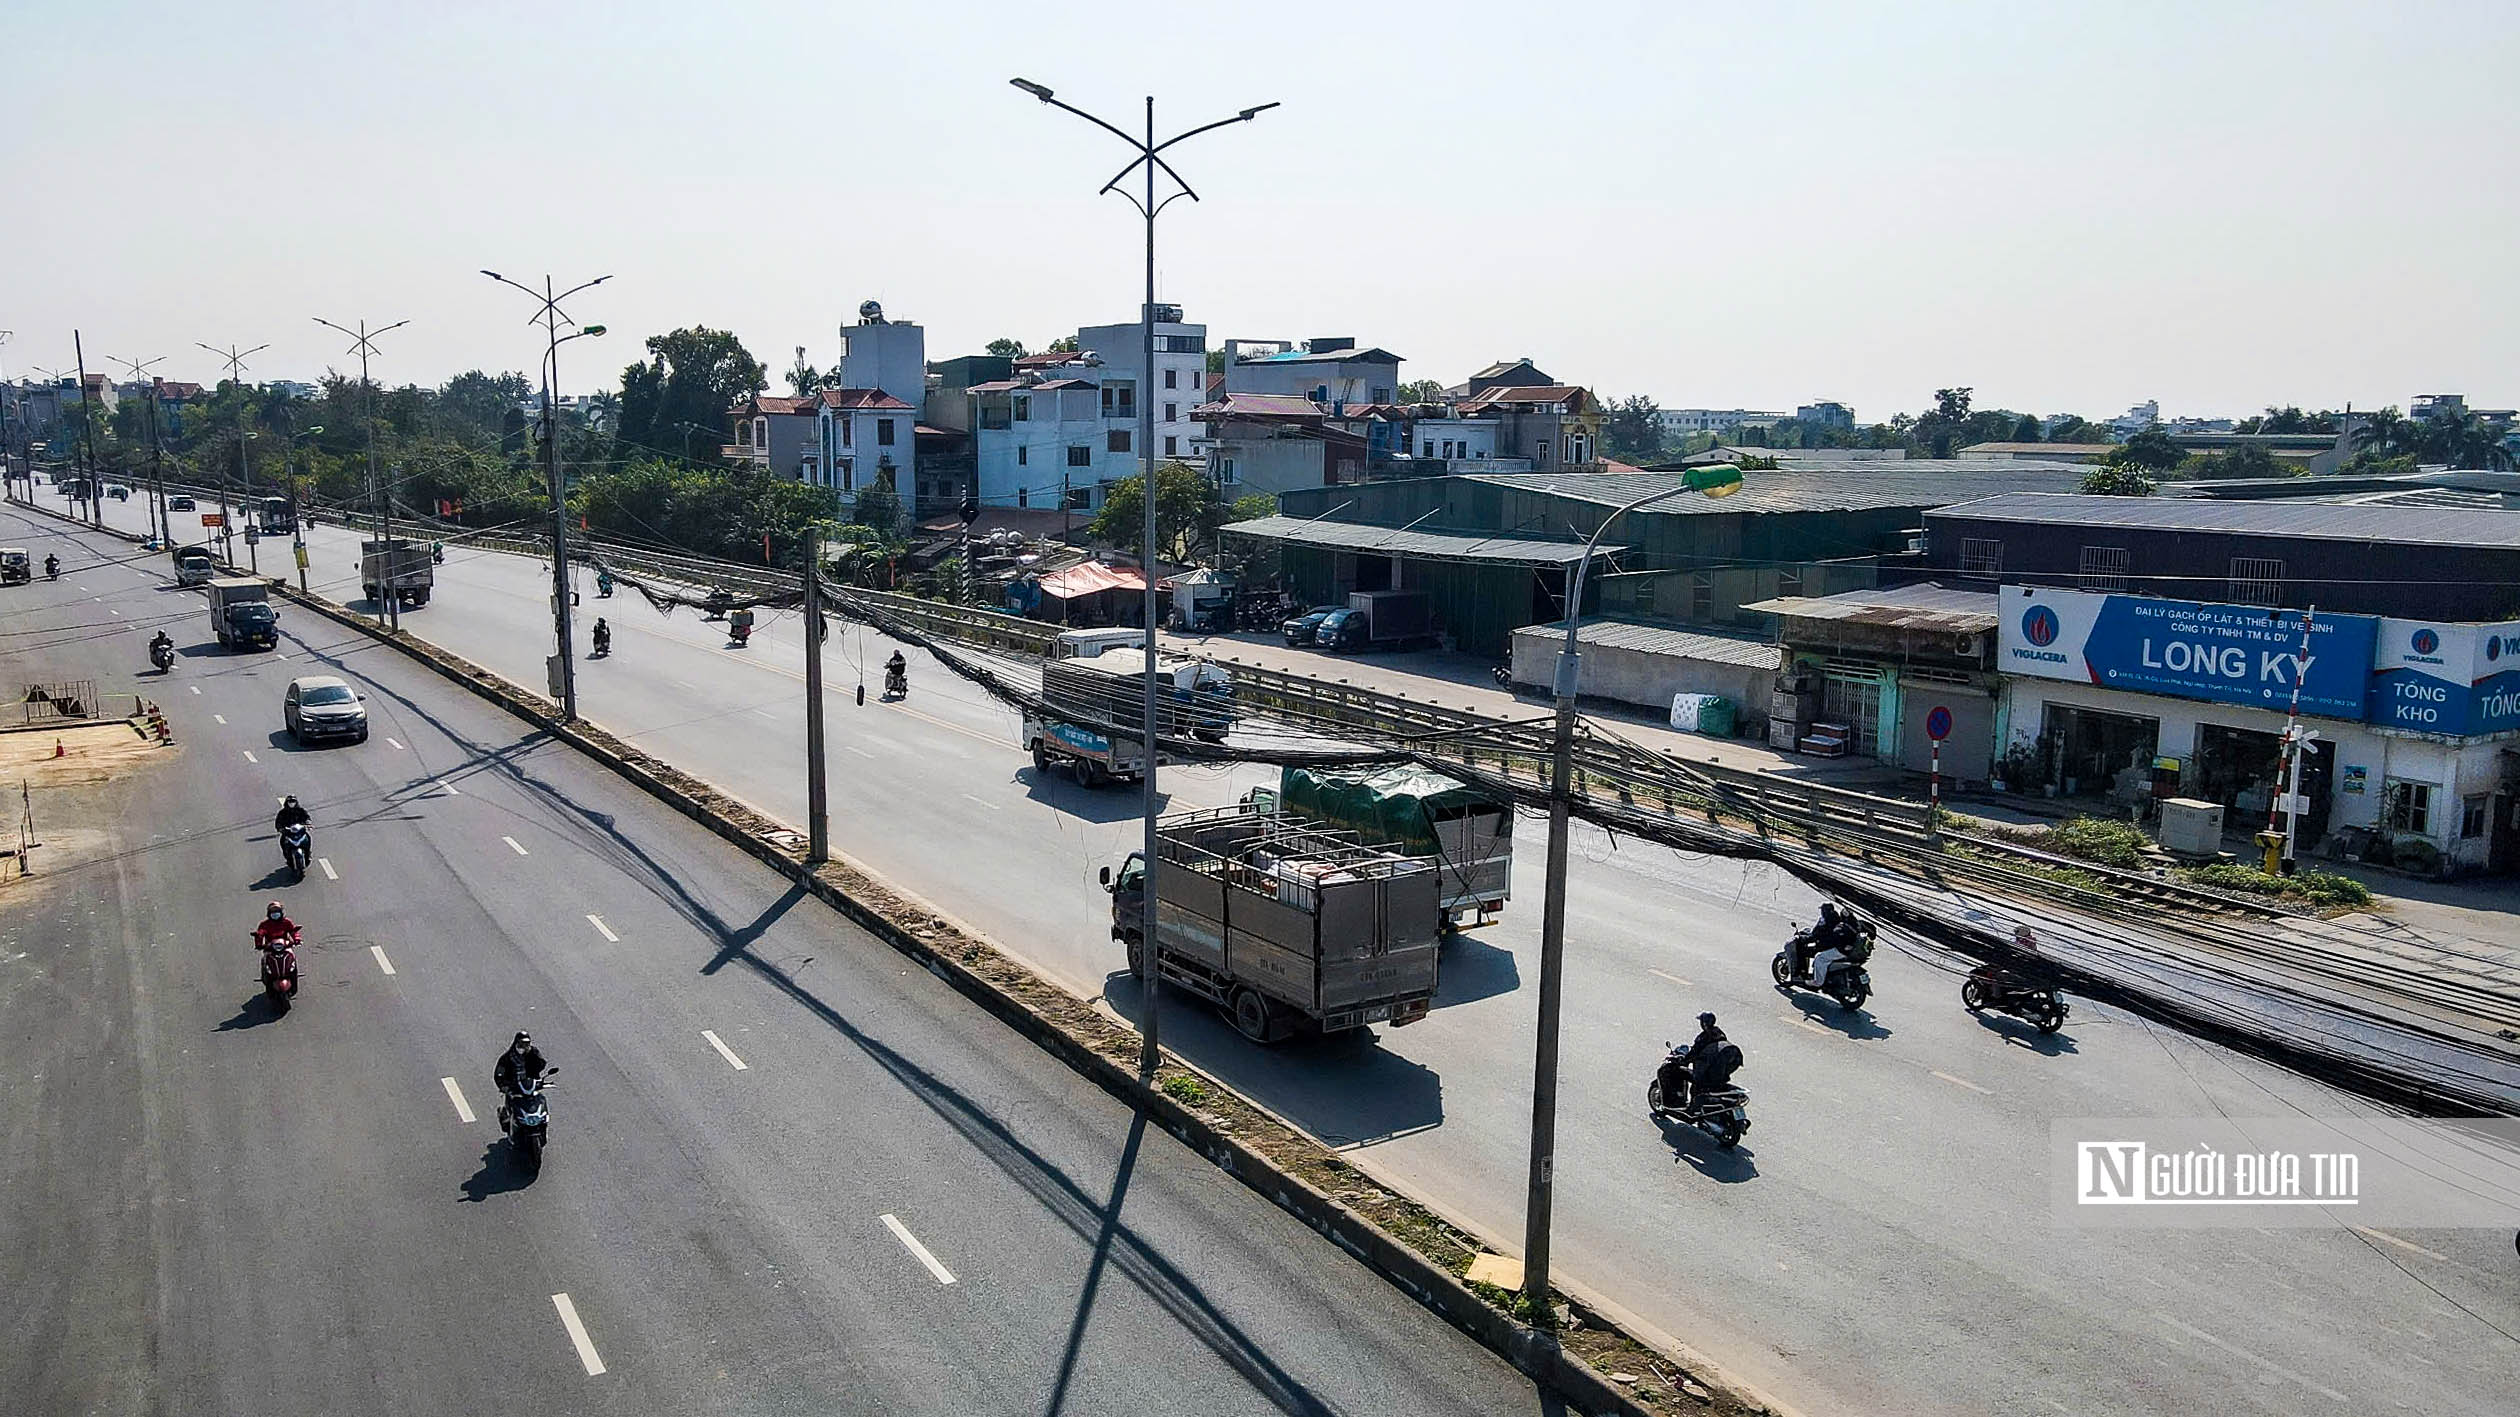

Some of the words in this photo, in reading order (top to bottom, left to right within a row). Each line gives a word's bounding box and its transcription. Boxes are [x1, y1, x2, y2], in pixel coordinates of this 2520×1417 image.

[2168, 609, 2195, 621] GẠCH
[2235, 616, 2243, 625] &
[2201, 625, 2215, 635] TY
[2215, 627, 2243, 638] TNHH
[2247, 630, 2262, 640] TM
[2263, 631, 2271, 641] &
[2273, 633, 2289, 643] DV
[2011, 648, 2069, 664] VIGLACERA
[2142, 638, 2247, 678] LONG
[2393, 679, 2447, 702] TỔNG
[2396, 704, 2438, 723] KHO
